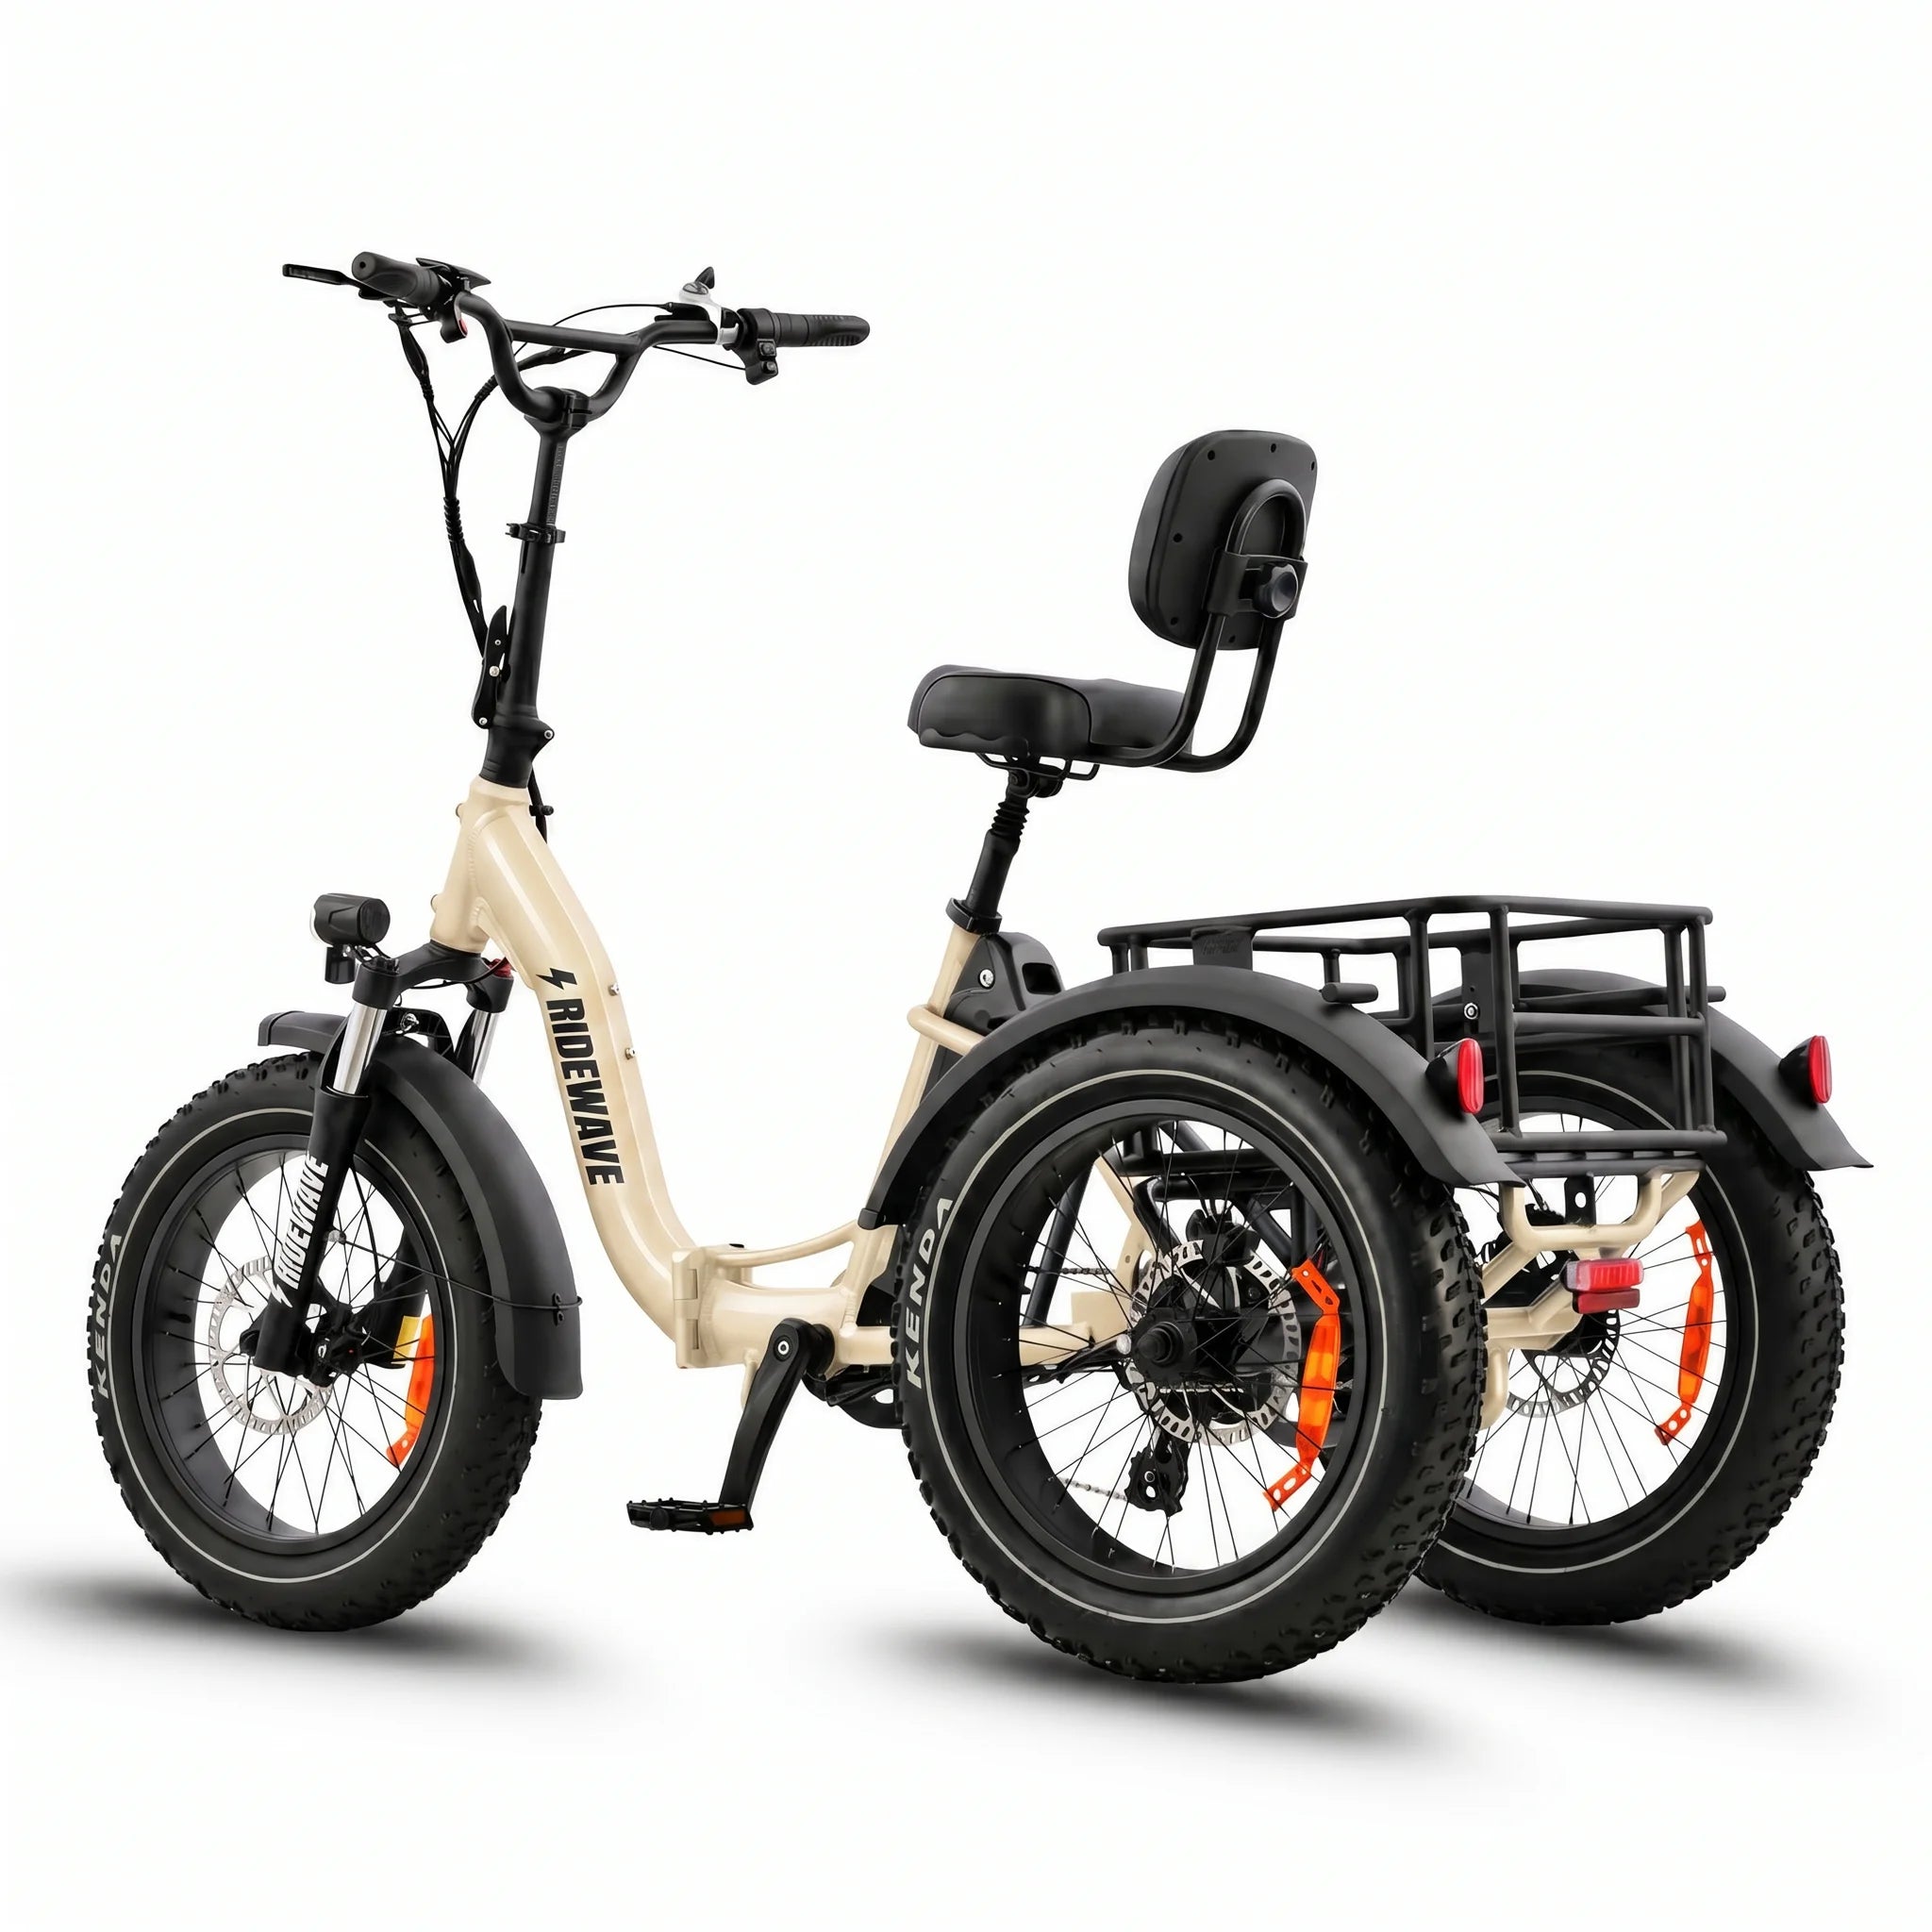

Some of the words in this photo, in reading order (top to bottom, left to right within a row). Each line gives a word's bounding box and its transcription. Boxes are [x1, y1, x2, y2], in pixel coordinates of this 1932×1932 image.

[546, 998, 625, 1185] RIDEWAVE
[95, 1234, 123, 1399] KENDA
[905, 1198, 954, 1390] KENDA
